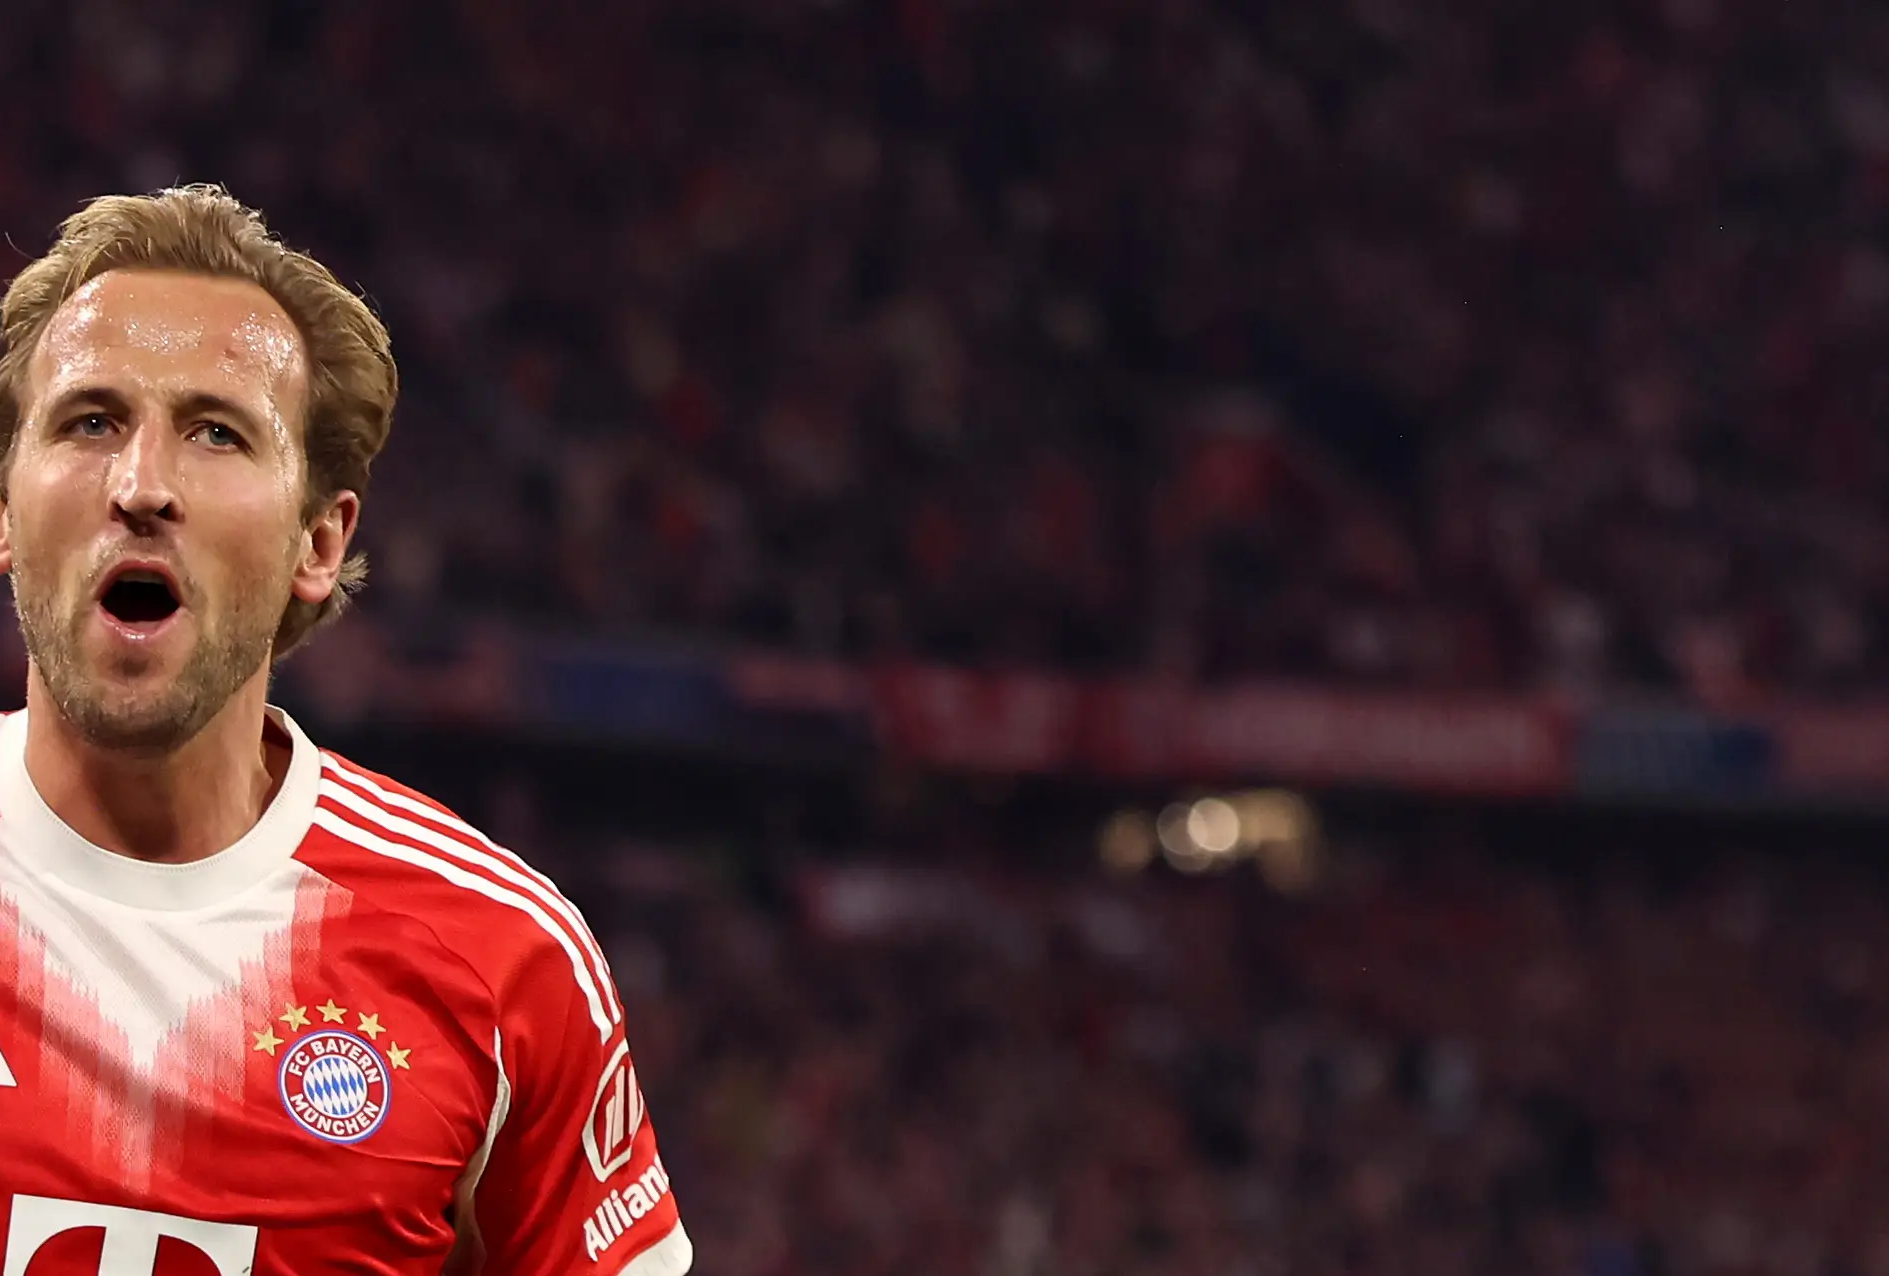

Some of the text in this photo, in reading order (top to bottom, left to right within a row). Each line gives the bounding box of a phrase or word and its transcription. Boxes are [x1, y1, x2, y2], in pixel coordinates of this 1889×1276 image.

[288, 1038, 381, 1084] FC BAYERN
[289, 1093, 380, 1136] MÜNCHEN
